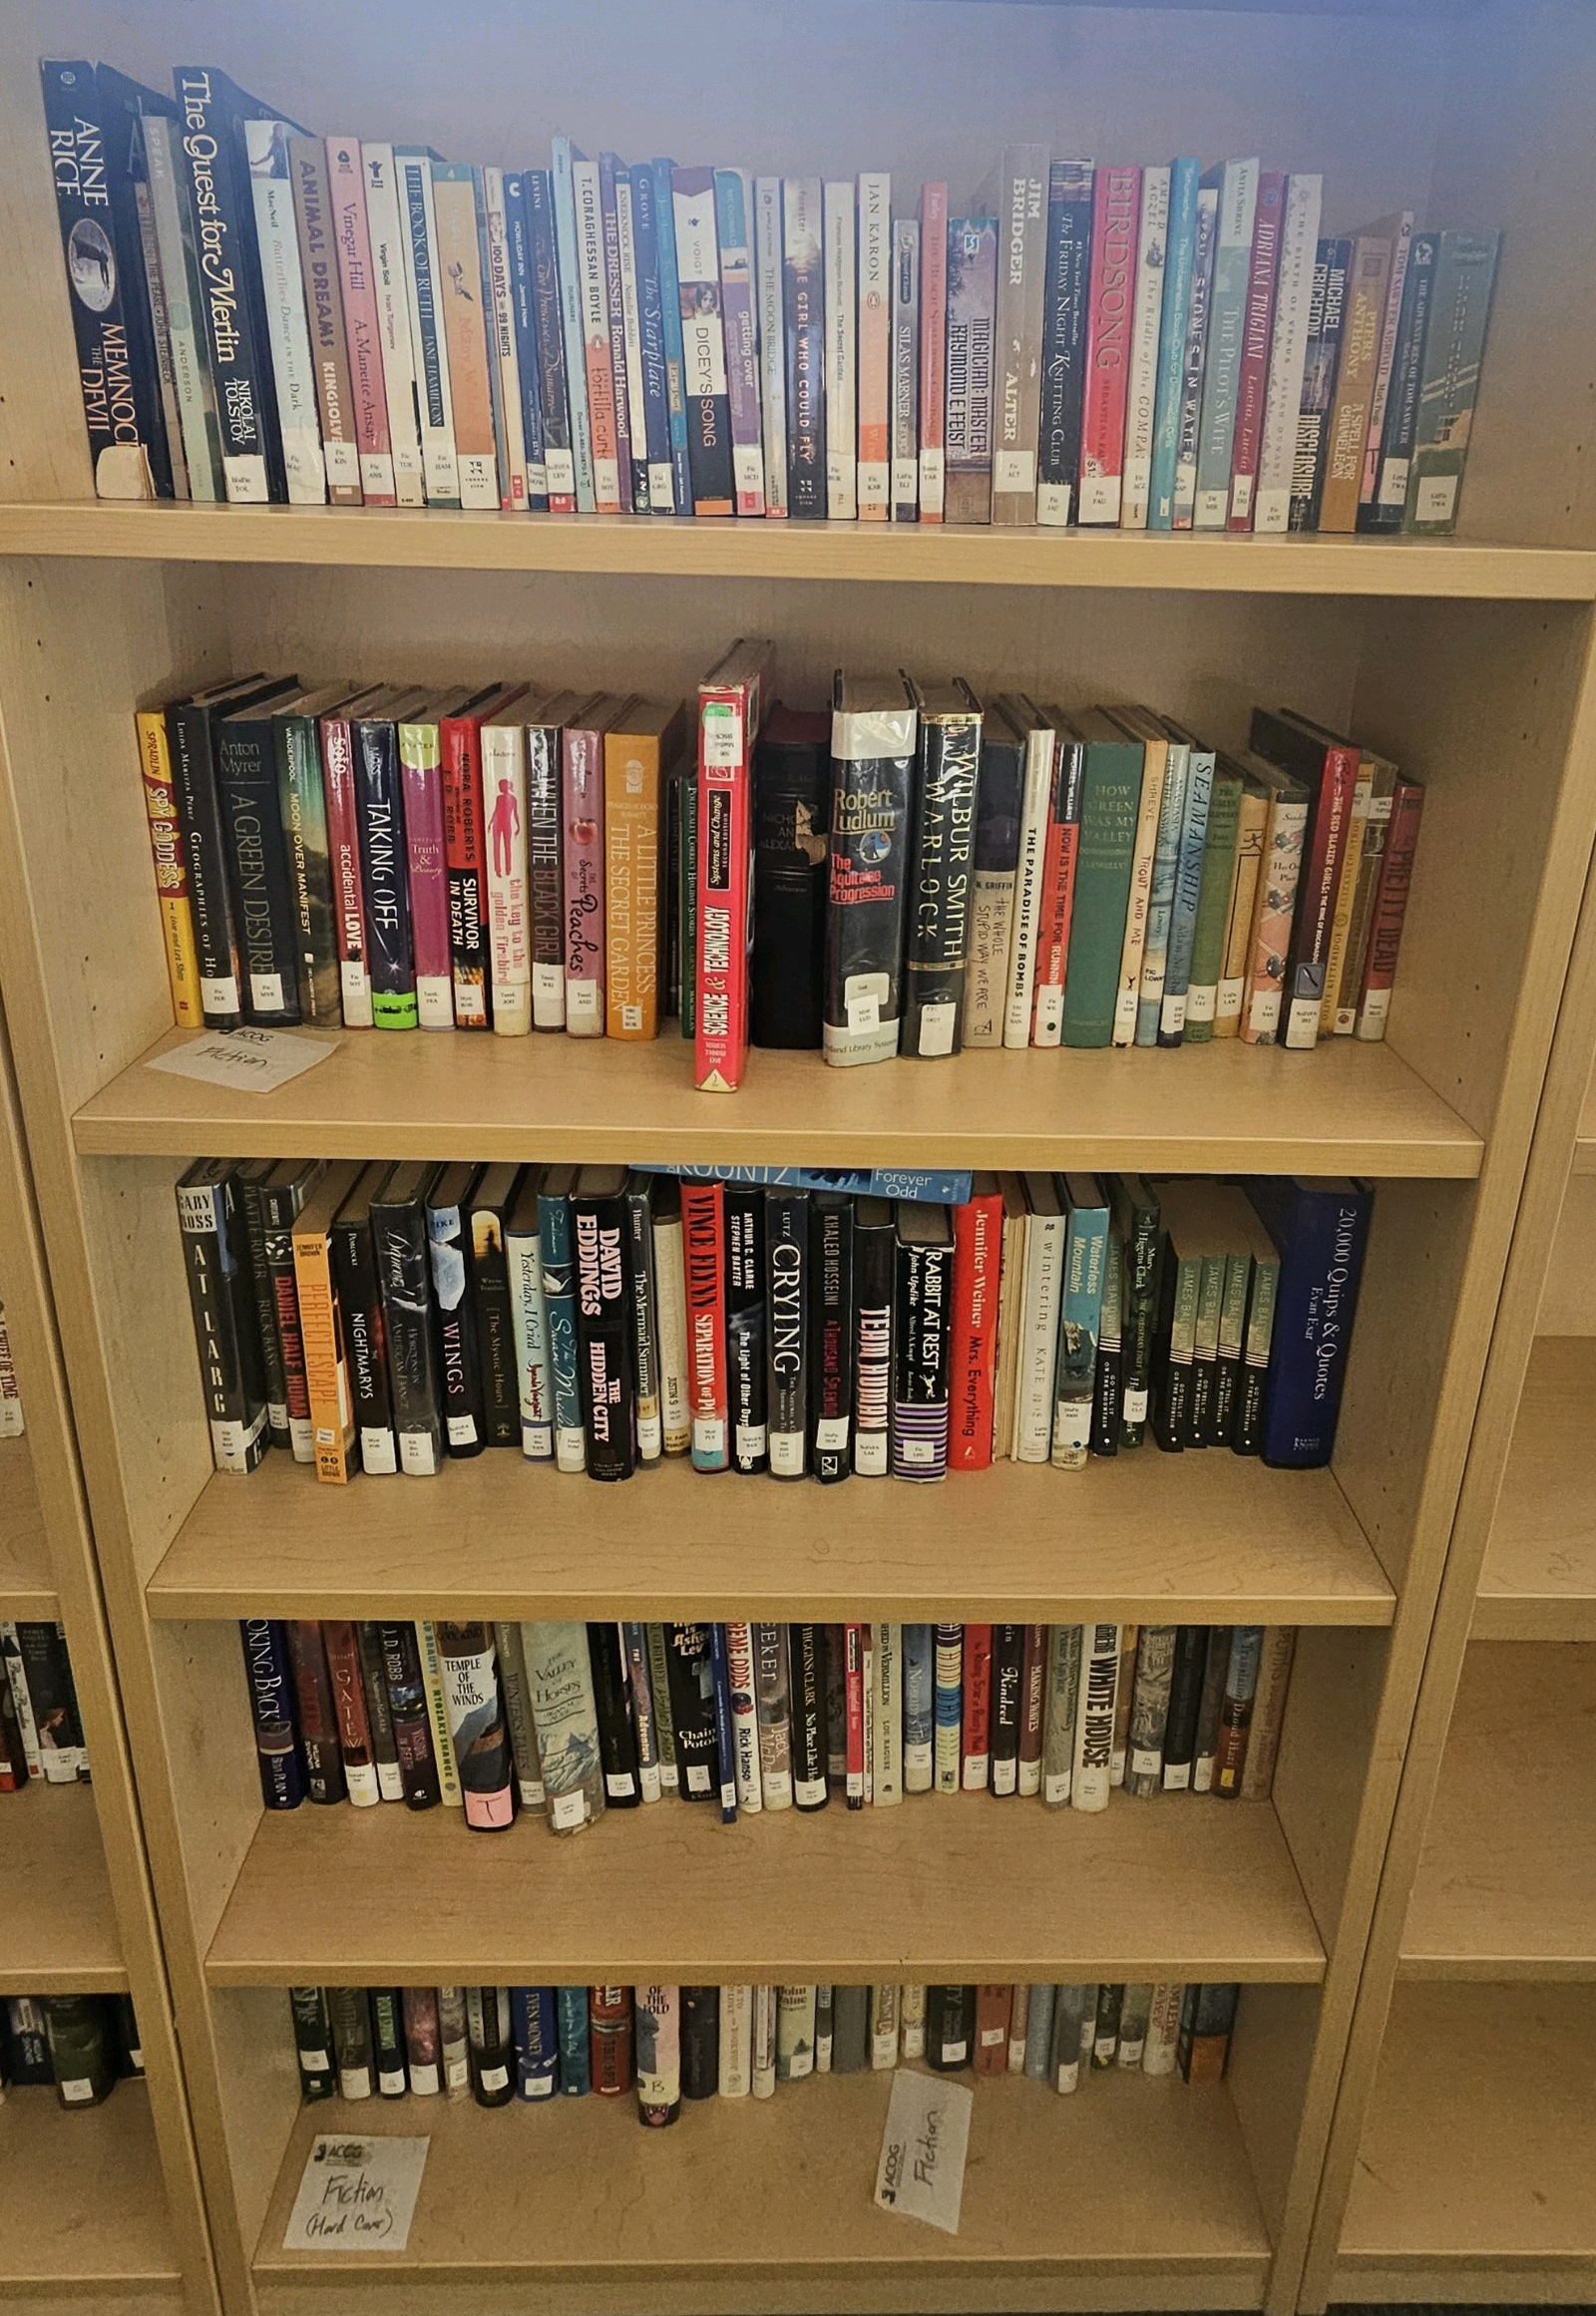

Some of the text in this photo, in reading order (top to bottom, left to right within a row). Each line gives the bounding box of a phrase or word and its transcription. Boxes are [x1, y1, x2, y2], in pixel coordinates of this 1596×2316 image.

[50, 130, 82, 195] RICE
[74, 117, 108, 206] ANNE
[182, 73, 239, 363] The Quest for Merlin
[868, 184, 880, 282] JAN KARON
[1008, 179, 1026, 285] BRIDGER
[1026, 179, 1041, 219] JIM
[299, 160, 334, 347] ANIMAL DREAMS
[340, 202, 365, 290] Vinegar Hill
[379, 243, 391, 285] Virgin Soil
[406, 168, 433, 319] THE BOOK OF RUTH
[493, 245, 507, 298] 100 DAYS
[581, 178, 601, 324] T. CORAGHESSAN BOYLE
[1095, 173, 1135, 371] BIRDSONG
[499, 312, 511, 357] 99 NIGHTS
[604, 209, 628, 438] THE DRESSER Ronald Harwood
[1048, 212, 1073, 466] The FRIDAY NIGHT KNITTING CLUB
[178, 341, 194, 403] ANDERSON
[353, 319, 377, 441] A. Manette Ansay
[695, 327, 716, 447] DICEY'S SONG
[797, 292, 811, 461] GIRL WHO COULD FLY
[899, 325, 911, 417] SILAS MARNER
[1003, 372, 1018, 441] ALTER
[222, 379, 243, 446] TOLSTOY
[236, 379, 256, 440] NIKOLAI
[146, 731, 162, 775] SPRADLIN
[285, 727, 296, 782] VANDERPOOL
[835, 788, 893, 811] Robert
[149, 787, 181, 890] SPY GODDESS
[288, 793, 309, 935] MOON OVER MANIFEST
[367, 799, 398, 930] TAKING OFF
[711, 795, 723, 885] Systems and Change
[917, 782, 945, 939] WARLOCK
[944, 755, 978, 958] WILBUR SMITH
[1182, 762, 1213, 913] SEAMANSHIP
[339, 844, 361, 950] accidental LOVE
[449, 880, 464, 946] IN DEATH
[462, 878, 479, 950] SURVIVOR
[569, 894, 598, 972] Peaches
[1014, 828, 1037, 997] THE PARADISE OF BOMBS
[704, 906, 730, 1035] SCIENCE & TECHNOLOGY
[197, 1046, 267, 1067] Fiction
[875, 1168, 933, 1186] Forever
[886, 1184, 918, 1199] Odd
[577, 1214, 601, 1316] EDDINGS
[598, 1228, 622, 1300] DAVID
[687, 1194, 718, 1309] VINCE FLYNN
[730, 1215, 741, 1287] STEPHEN BAXTER
[742, 1212, 754, 1246] ARTHUR
[823, 1215, 841, 1306] KHALED HOSSEINI
[1068, 1237, 1086, 1293] Mountain
[1086, 1235, 1104, 1295] Waterless
[520, 1251, 536, 1307] Yesterday,
[744, 1259, 754, 1290] CLARKE
[772, 1211, 801, 1374] LUTZ CRYING
[908, 1253, 920, 1306] John Updike
[922, 1251, 943, 1369] RABBIT AT REST
[1313, 1208, 1357, 1400] 20,000 Quips & Quotes
[526, 1318, 539, 1350] Cried
[634, 1271, 650, 1396] The Mermaid Summer
[739, 1332, 750, 1347] The
[962, 1209, 989, 1437] Jennifer Weiner Mrs. Everything
[1033, 1242, 1054, 1383] wintering KATE
[350, 1313, 373, 1399] NIGHTMARYS
[442, 1322, 464, 1394] WINGS
[589, 1342, 609, 1442] HIDDEN CITY
[607, 1377, 621, 1404] THE
[738, 1349, 750, 1370] Light
[739, 1408, 752, 1427] Days
[740, 1383, 752, 1405] Other
[254, 1676, 282, 1720] BACK
[385, 1655, 403, 1681] ROBB
[444, 1658, 481, 1672] TEMPLE
[452, 1694, 484, 1706] WINDS
[457, 1684, 477, 1695] THE
[458, 1672, 468, 1682] OF
[730, 1658, 750, 1688] ODDS
[802, 1627, 815, 1706] HIGGINS CLARK
[881, 1652, 893, 1706] VERMILLION
[999, 1667, 1018, 1726] Kindred
[739, 1728, 751, 1748] Rick
[1082, 1657, 1116, 1768] WHITE HOUSE
[885, 2144, 900, 2186] ACOG
[914, 2111, 939, 2187] Fiction
[322, 2172, 384, 2204] Fiction
